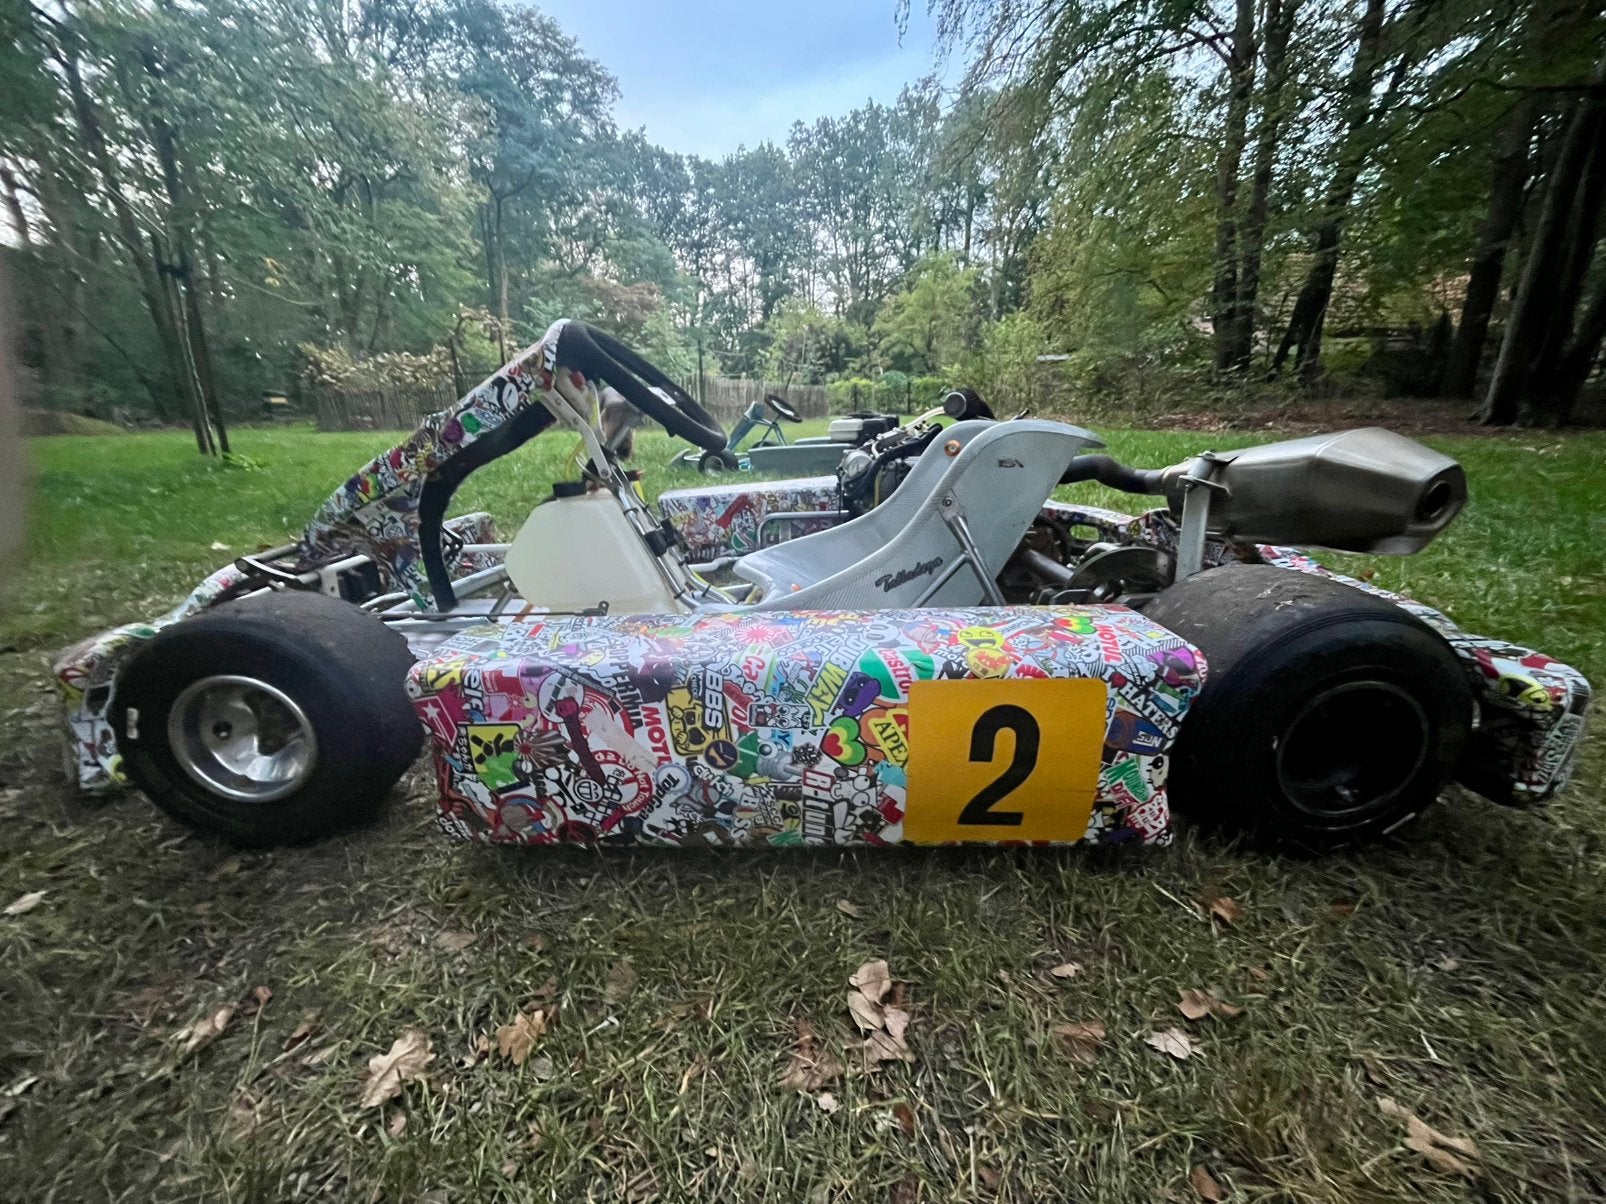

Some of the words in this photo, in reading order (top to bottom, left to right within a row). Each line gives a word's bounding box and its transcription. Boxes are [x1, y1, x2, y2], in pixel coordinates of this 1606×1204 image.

[1097, 624, 1122, 663] MOTUL
[705, 669, 724, 729] BBS
[1120, 682, 1180, 738] HATERS
[956, 703, 1041, 827] 2
[622, 790, 650, 812] Touch
[639, 773, 681, 821] TopGea
